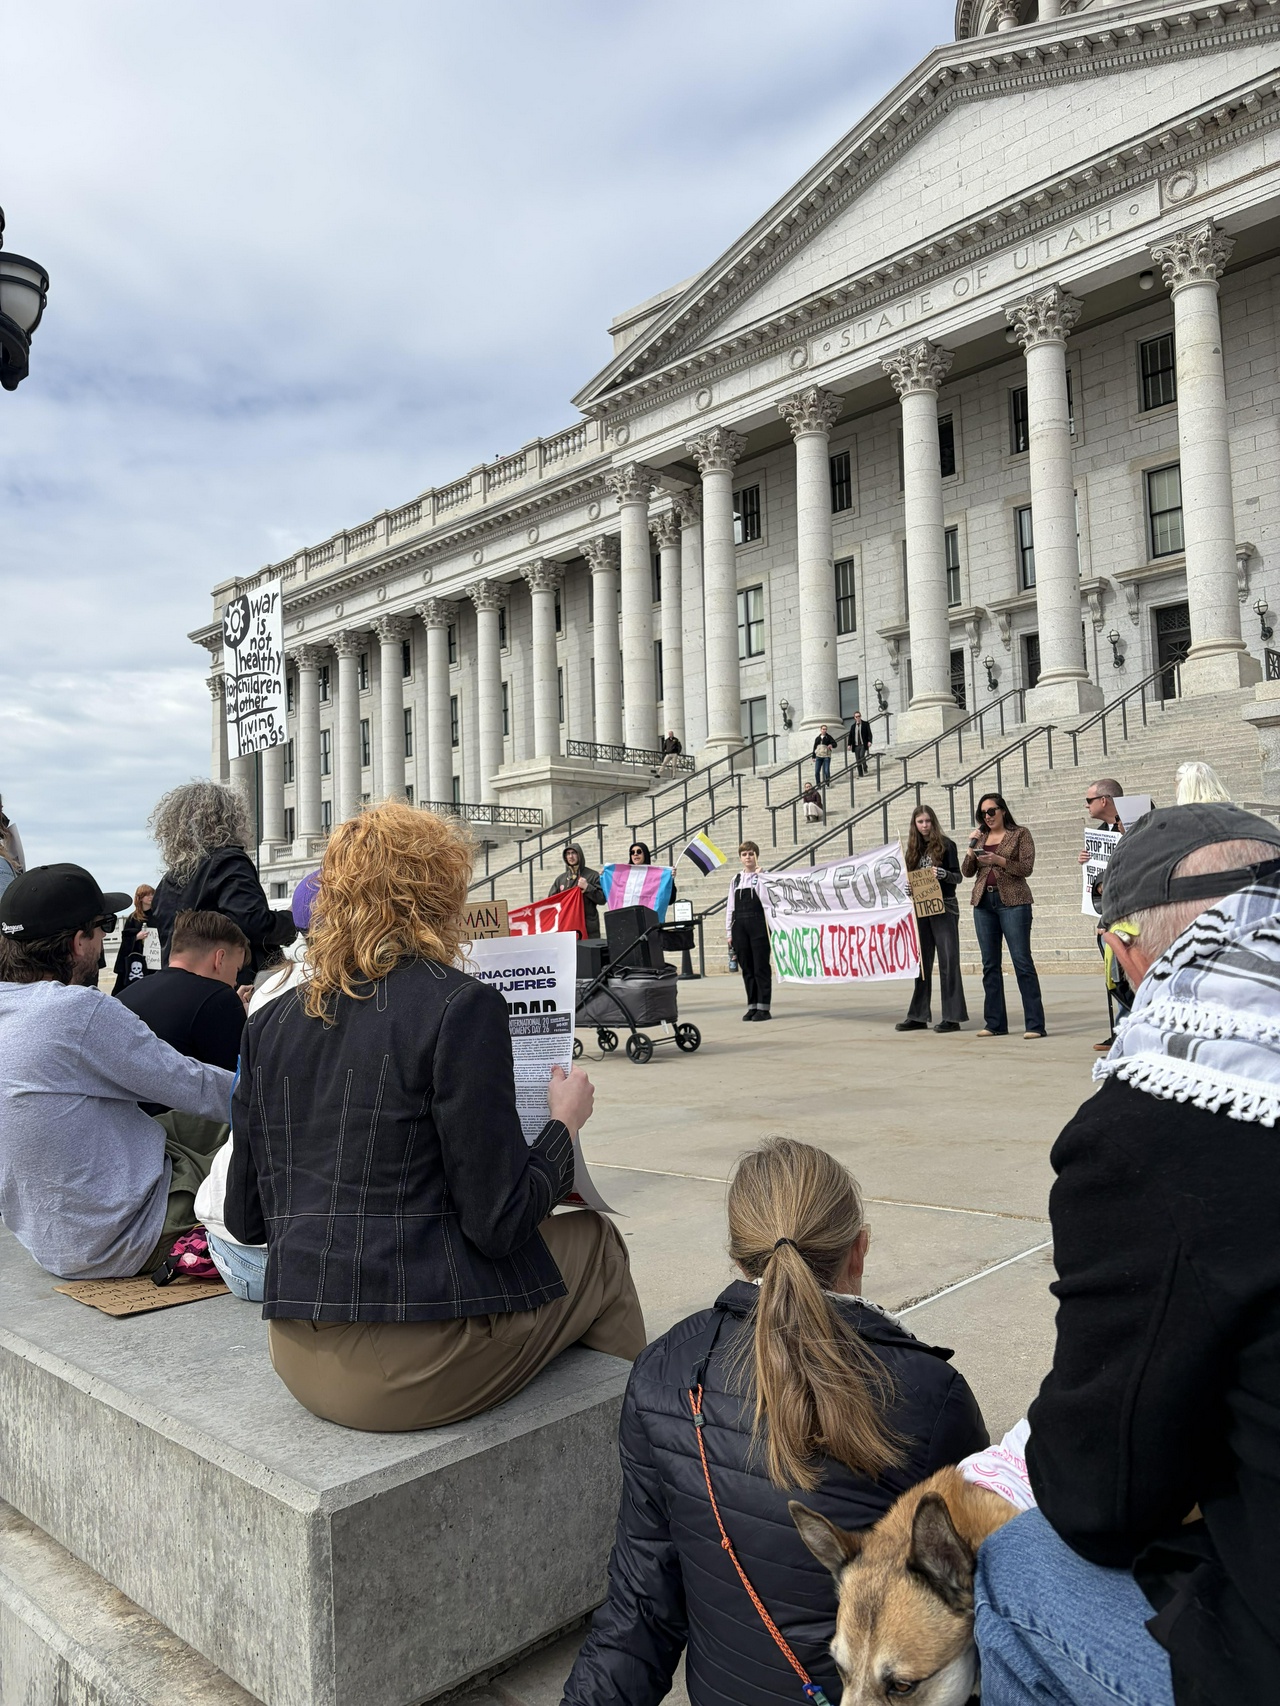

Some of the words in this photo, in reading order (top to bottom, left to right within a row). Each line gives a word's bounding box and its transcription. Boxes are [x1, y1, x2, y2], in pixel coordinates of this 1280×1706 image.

[839, 291, 934, 350] STATE
[952, 264, 990, 298] OF
[1012, 210, 1114, 271] UTAH
[250, 591, 280, 619] war
[257, 616, 267, 636] is
[250, 632, 272, 651] not
[239, 648, 282, 675] healthy
[238, 678, 282, 695] children
[239, 694, 269, 713] other
[240, 713, 275, 738] living
[241, 725, 285, 754] things
[1086, 840, 1102, 852] STOP
[833, 856, 907, 911] FOR
[912, 871, 923, 880] AND
[912, 877, 935, 887] GETTING
[915, 884, 940, 901] FUCKING
[916, 897, 944, 916] TIRED
[771, 927, 825, 978] GENDER
[820, 913, 920, 978] LIBERATION
[509, 1018, 541, 1029] NTERNATIONAL
[532, 1025, 542, 1034] DAY
